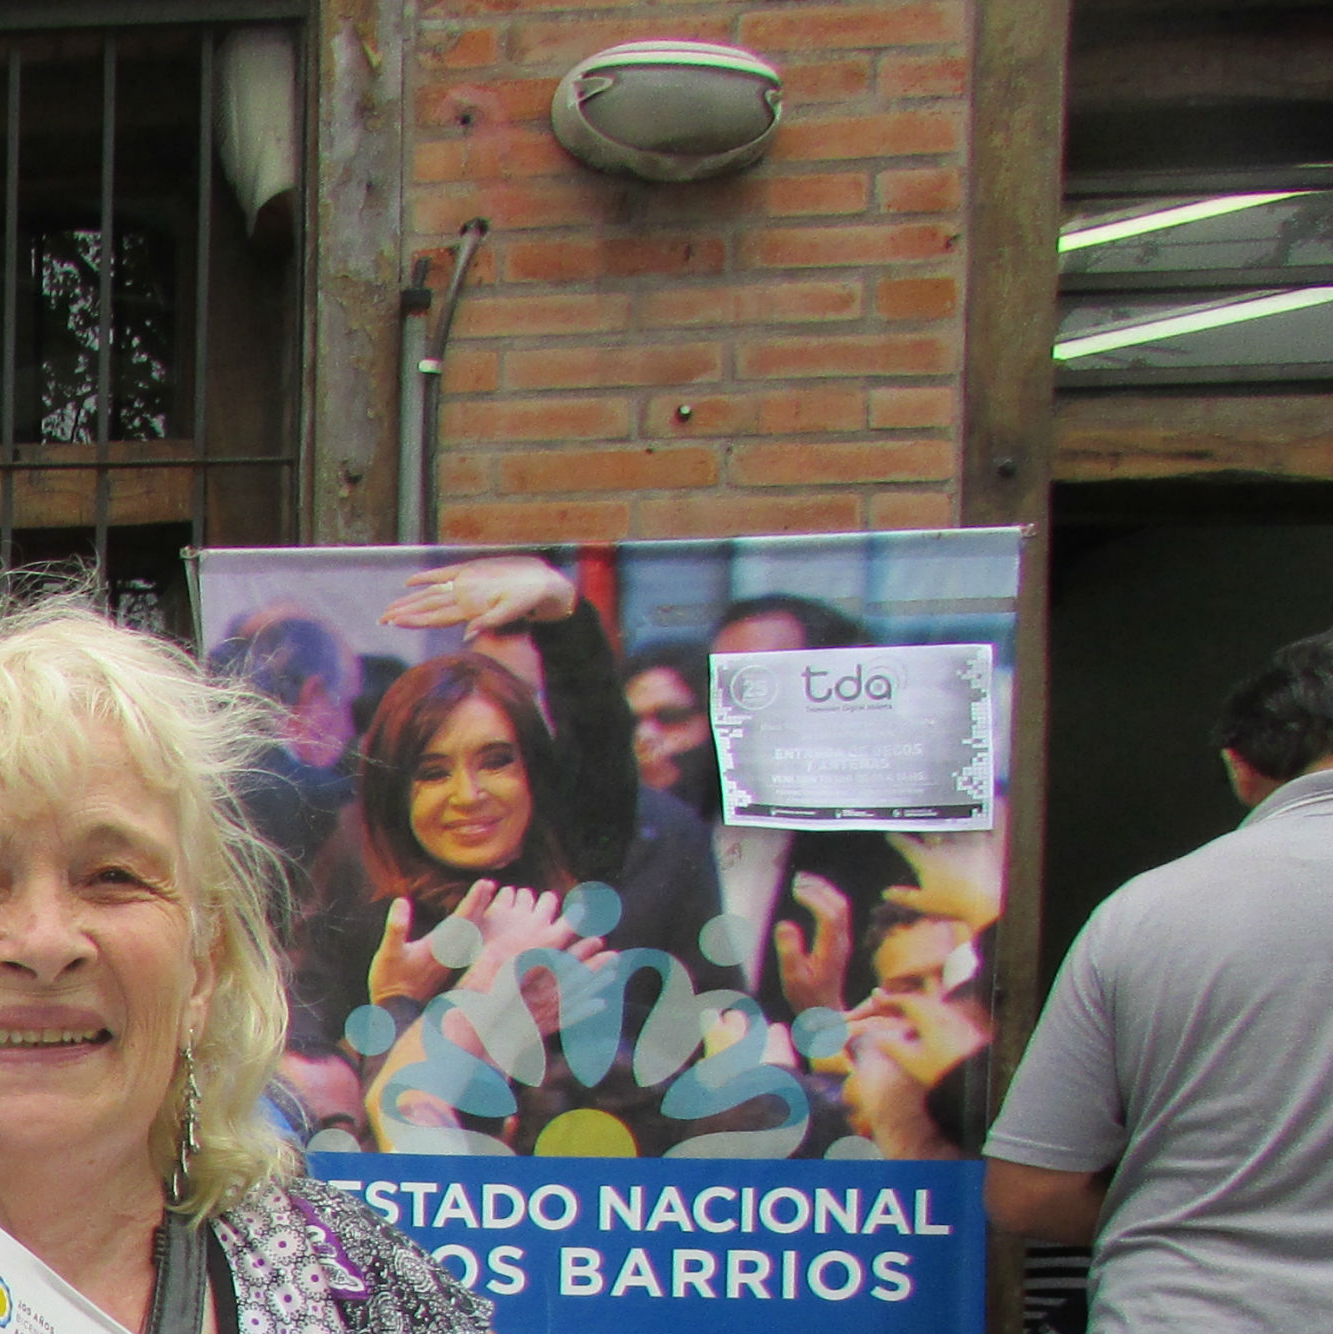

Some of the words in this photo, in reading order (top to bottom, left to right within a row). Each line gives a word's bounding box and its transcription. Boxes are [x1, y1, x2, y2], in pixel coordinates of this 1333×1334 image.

[801, 663, 893, 702] tda
[328, 1180, 577, 1231] STADO
[598, 1185, 952, 1236] NACIONAL
[433, 1243, 526, 1296] OS
[560, 1246, 913, 1302] BARRIOS
